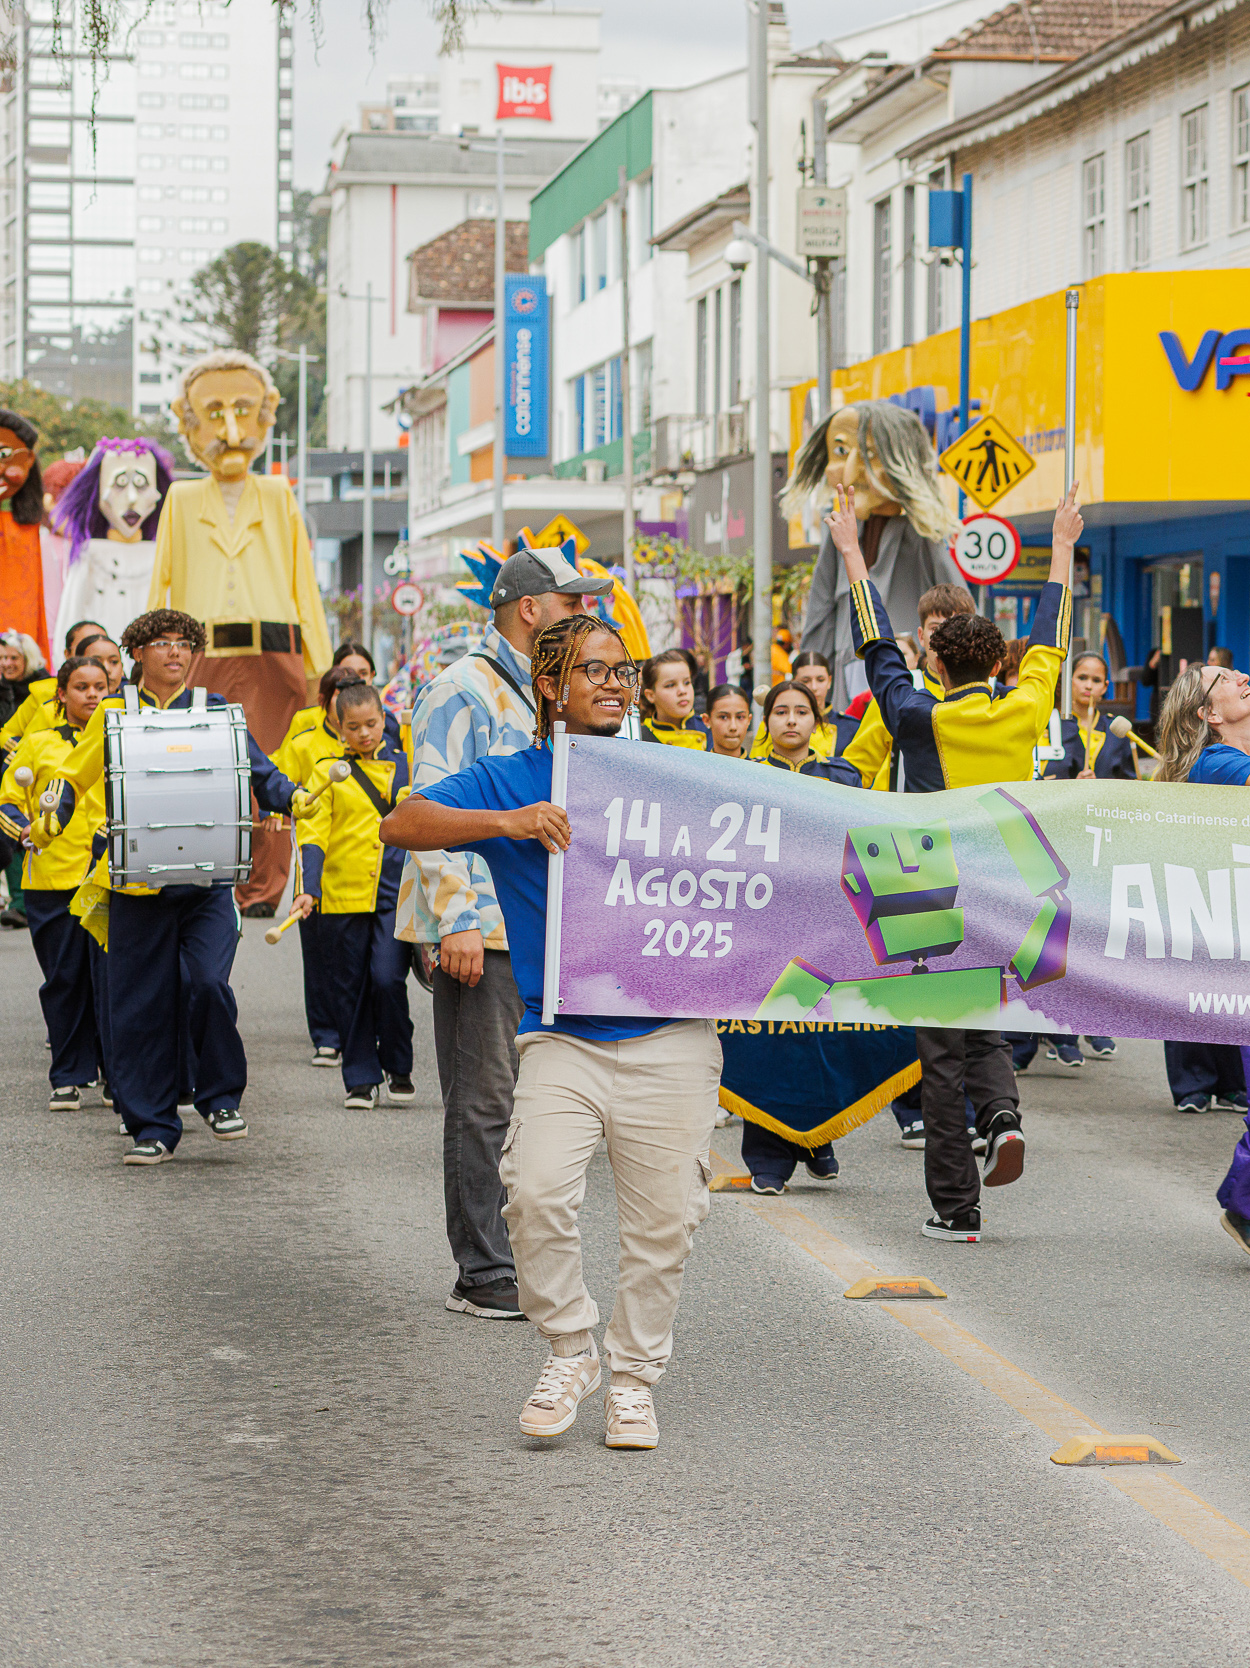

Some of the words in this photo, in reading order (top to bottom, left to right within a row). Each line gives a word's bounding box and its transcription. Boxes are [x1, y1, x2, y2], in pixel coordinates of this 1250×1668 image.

[503, 76, 547, 104] ibis
[964, 531, 1006, 560] 30
[604, 797, 661, 857] 14
[671, 826, 692, 856] A
[706, 802, 781, 862] 24
[1086, 804, 1151, 822] Fundação
[1155, 811, 1238, 827] Catarinense
[604, 859, 774, 910] AGOSTO
[641, 919, 733, 958] 2025
